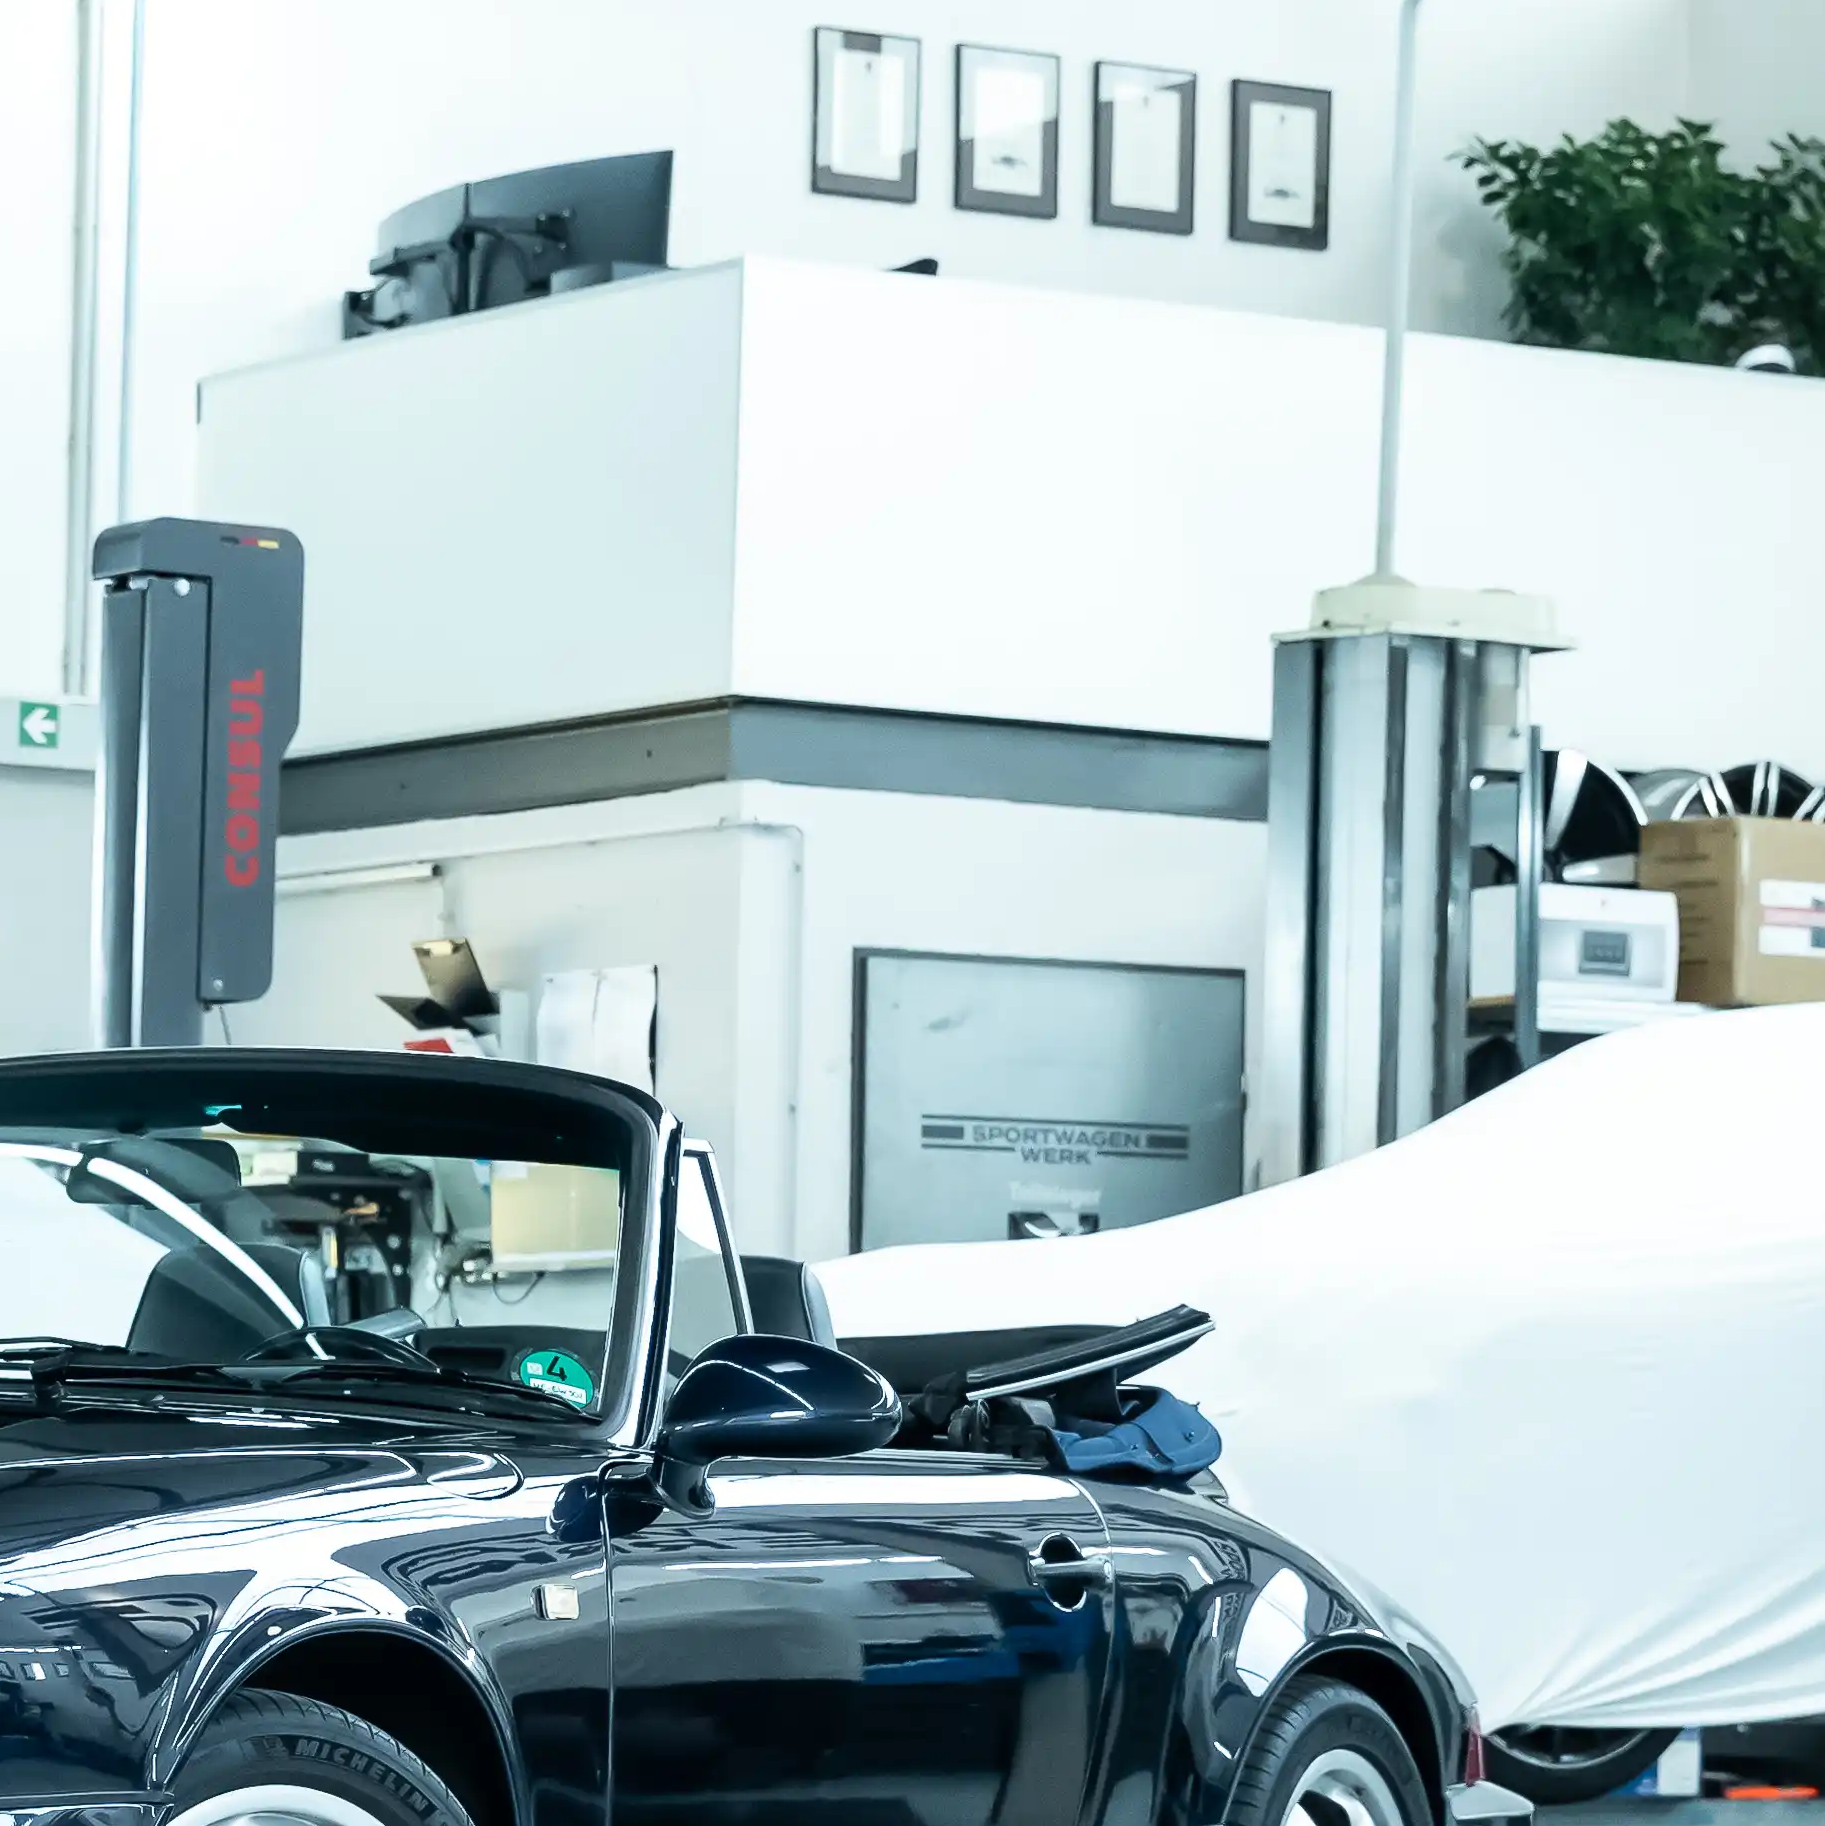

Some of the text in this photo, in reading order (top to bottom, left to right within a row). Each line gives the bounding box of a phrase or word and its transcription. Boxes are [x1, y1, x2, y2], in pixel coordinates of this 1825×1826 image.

[224, 669, 265, 888] CONSUL
[971, 1124, 1142, 1150] SPORTWAGEN
[1020, 1146, 1092, 1165] WERK
[546, 1355, 568, 1382] 4
[294, 1738, 430, 1813] MICHELIN
